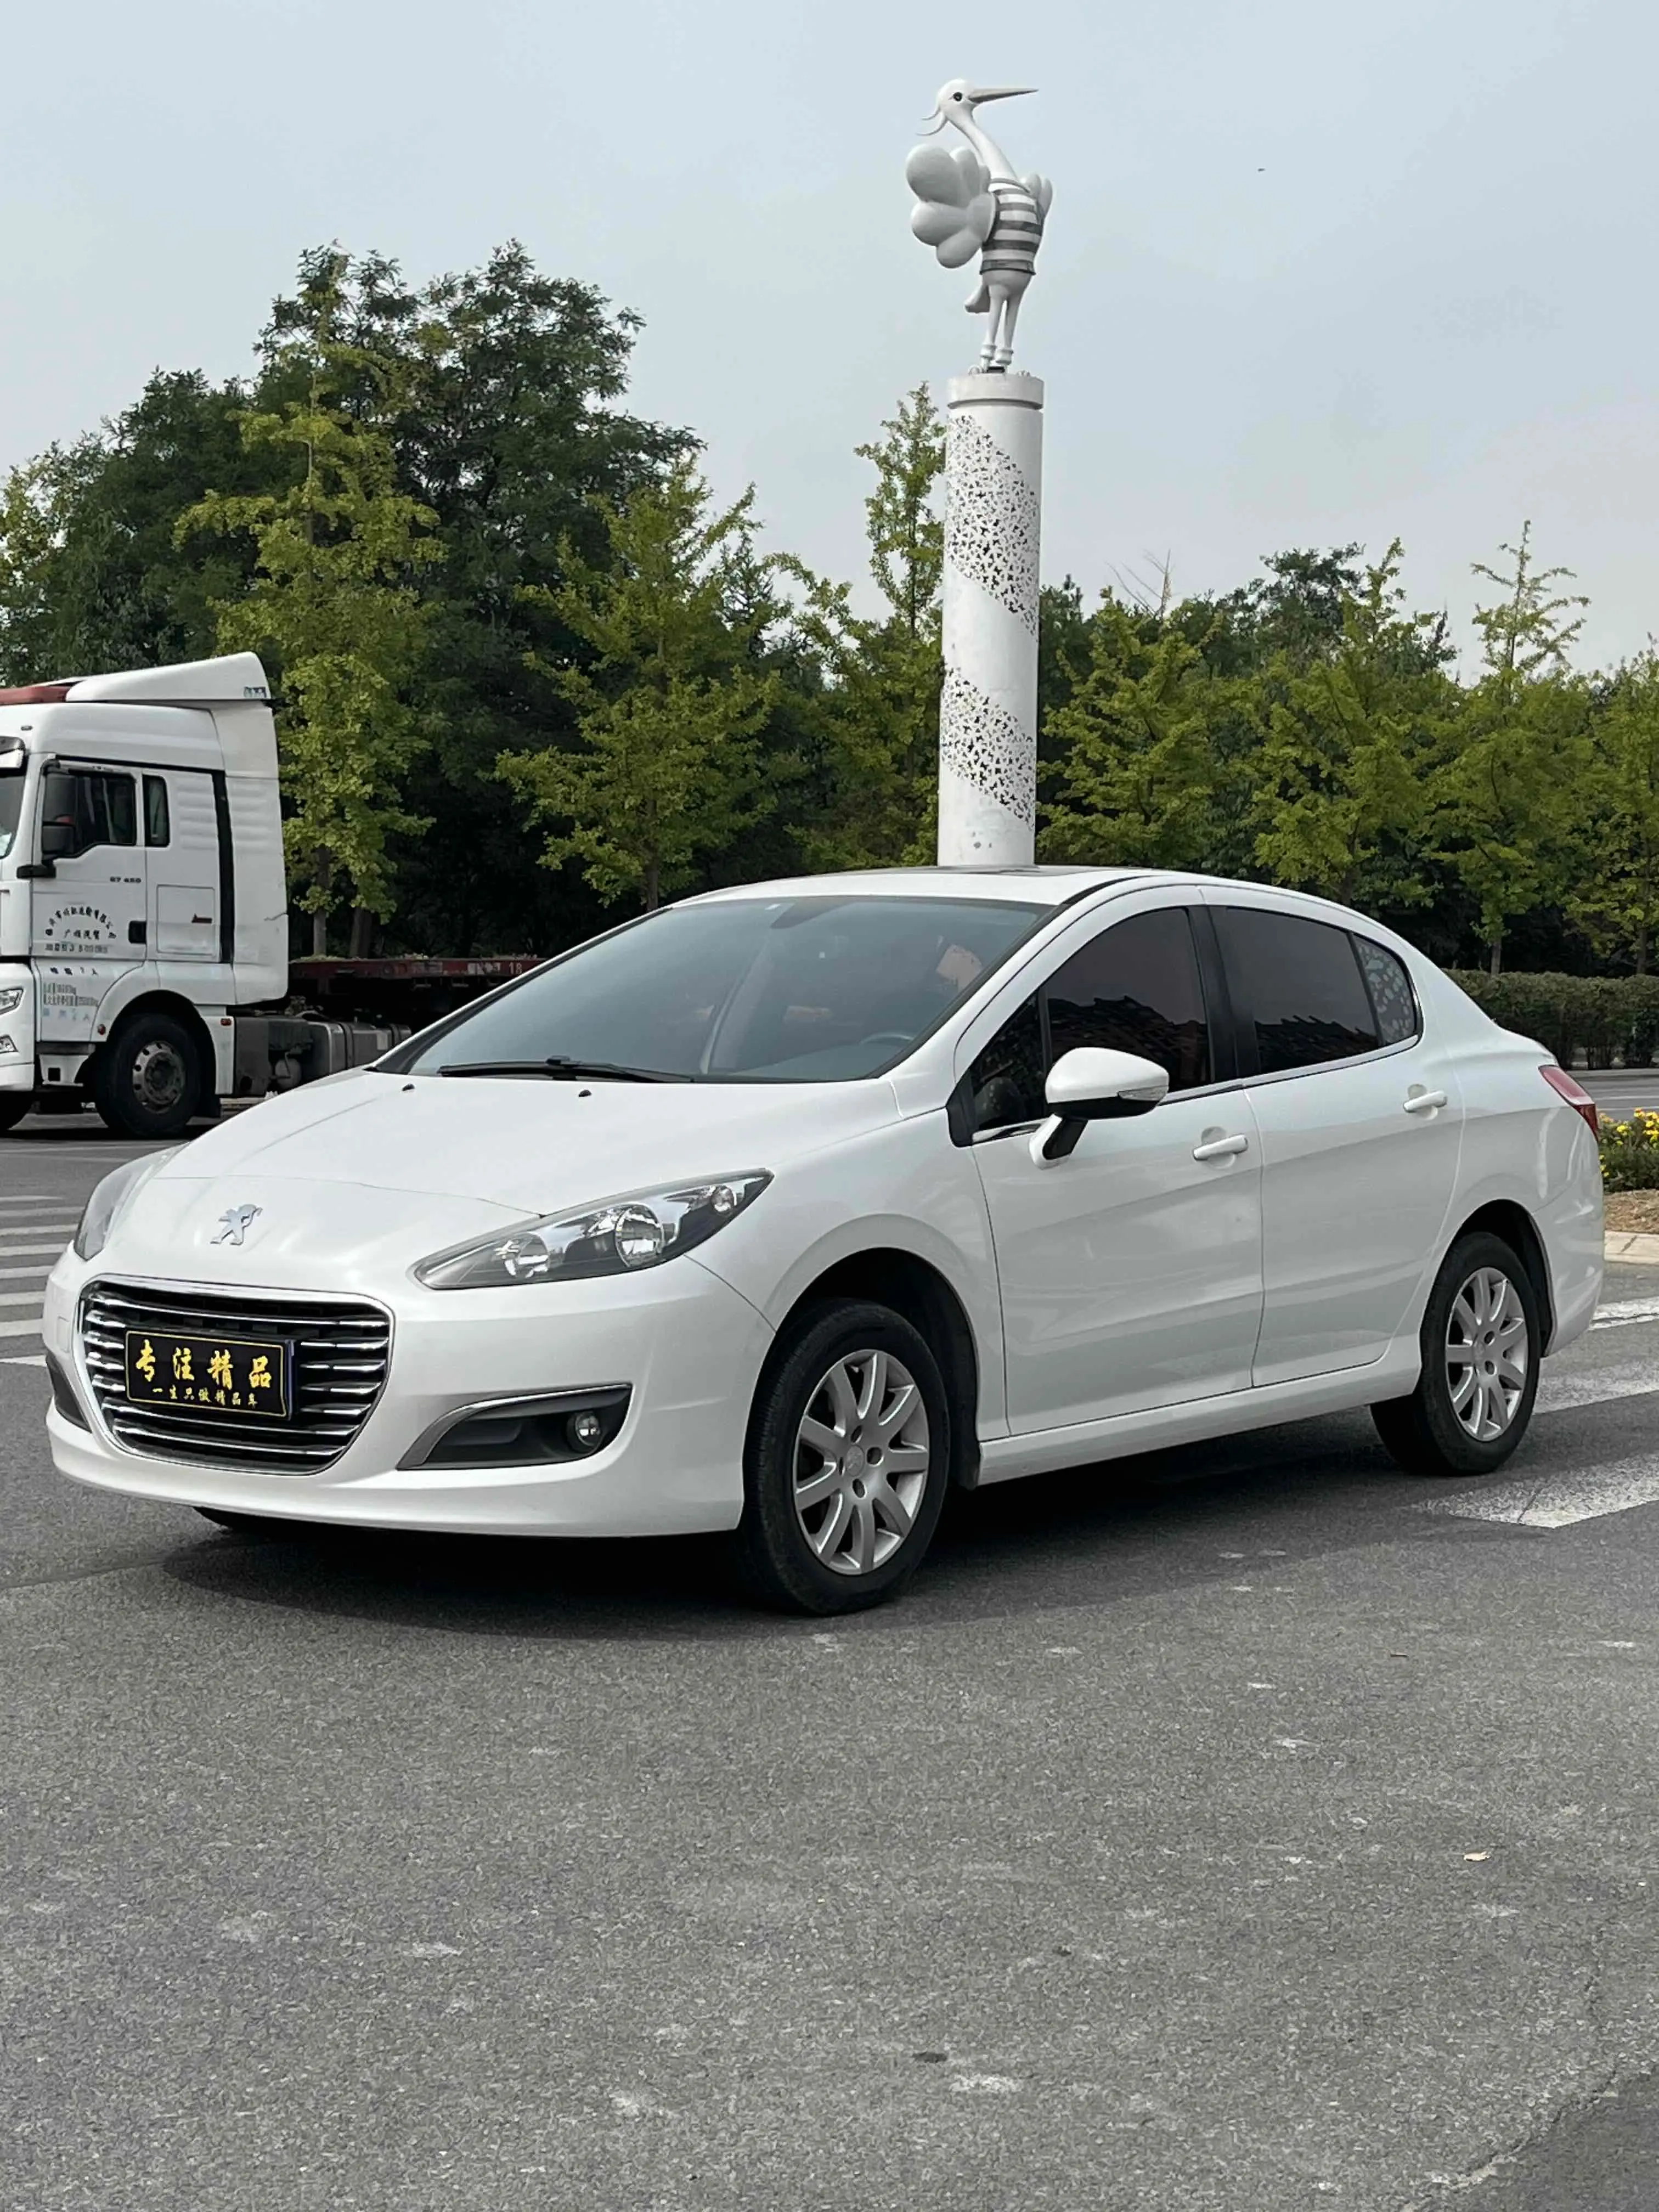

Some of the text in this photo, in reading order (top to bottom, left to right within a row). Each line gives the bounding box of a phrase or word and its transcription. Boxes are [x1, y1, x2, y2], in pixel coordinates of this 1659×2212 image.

[509, 961, 522, 974] 18
[136, 1339, 272, 1391] 专注精品
[152, 1384, 258, 1409] 一生只做精品车
